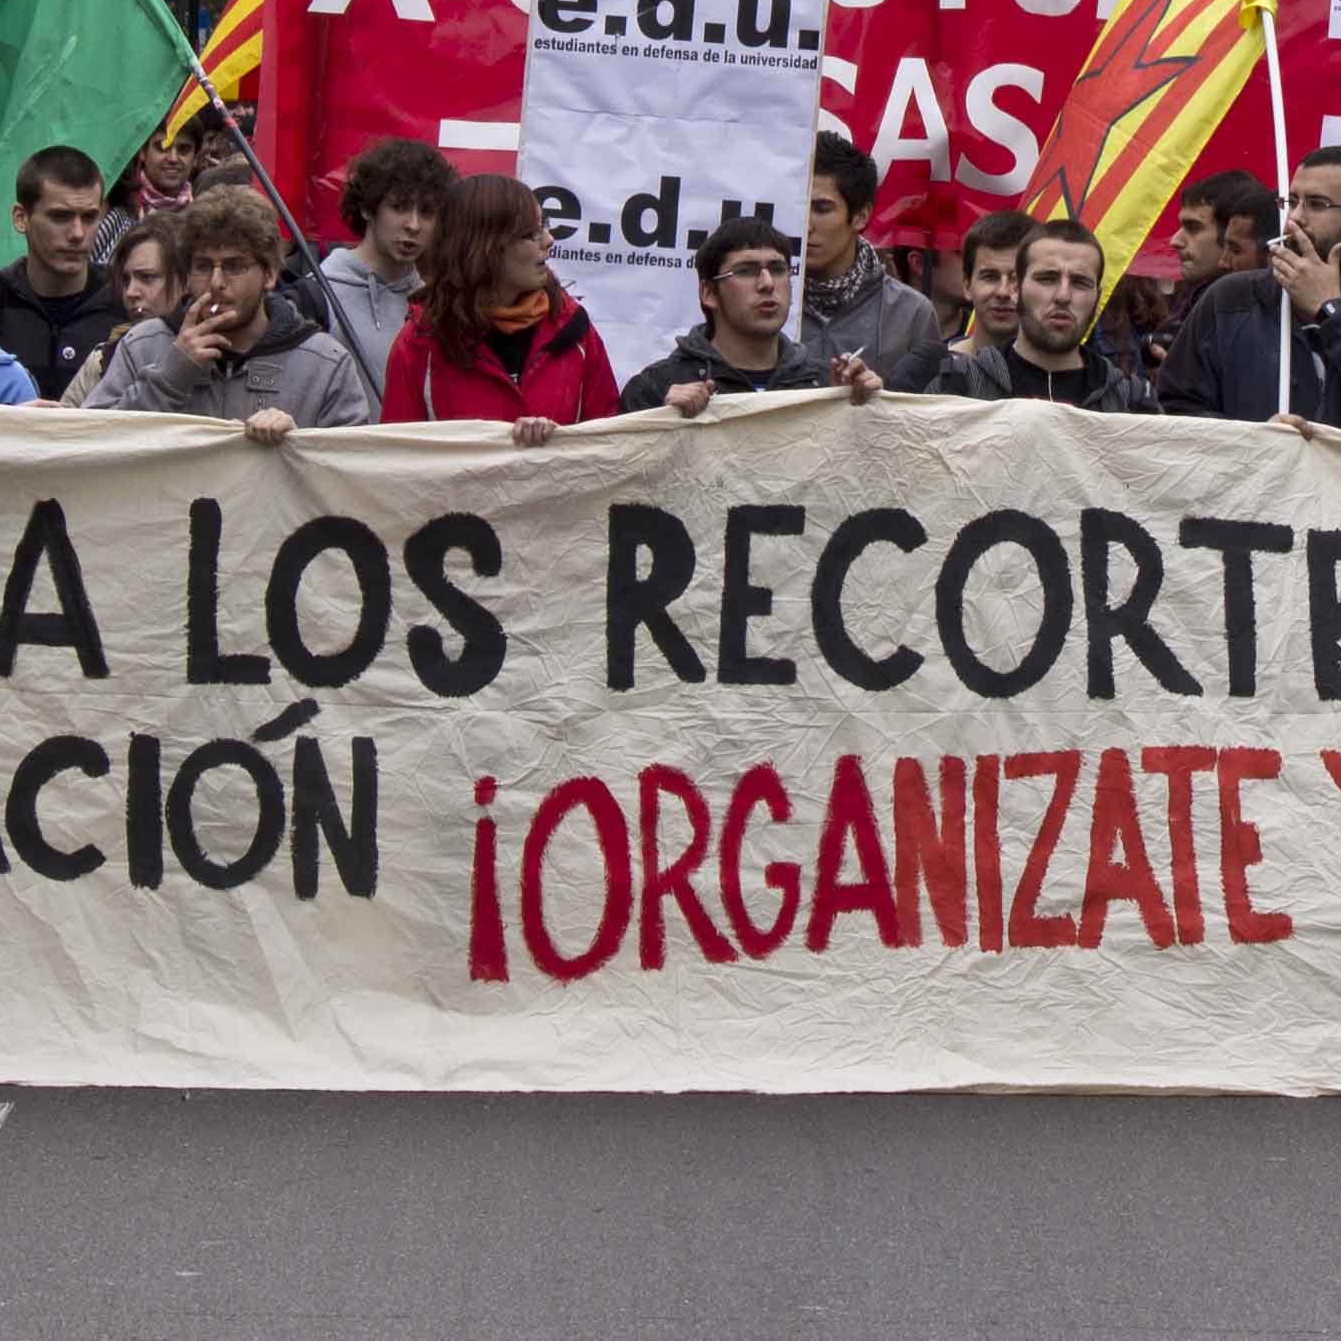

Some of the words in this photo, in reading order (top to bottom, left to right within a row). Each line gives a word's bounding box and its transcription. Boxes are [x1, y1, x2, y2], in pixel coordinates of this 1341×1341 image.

[534, 37, 618, 56] estudiantes
[621, 44, 639, 57] en
[643, 44, 698, 62] defensa
[703, 48, 720, 63] de
[723, 49, 736, 65] la
[740, 52, 818, 71] universidad
[548, 247, 601, 263] diantes
[605, 252, 622, 265] en
[626, 250, 682, 269] defensa
[188, 497, 508, 699] LOS
